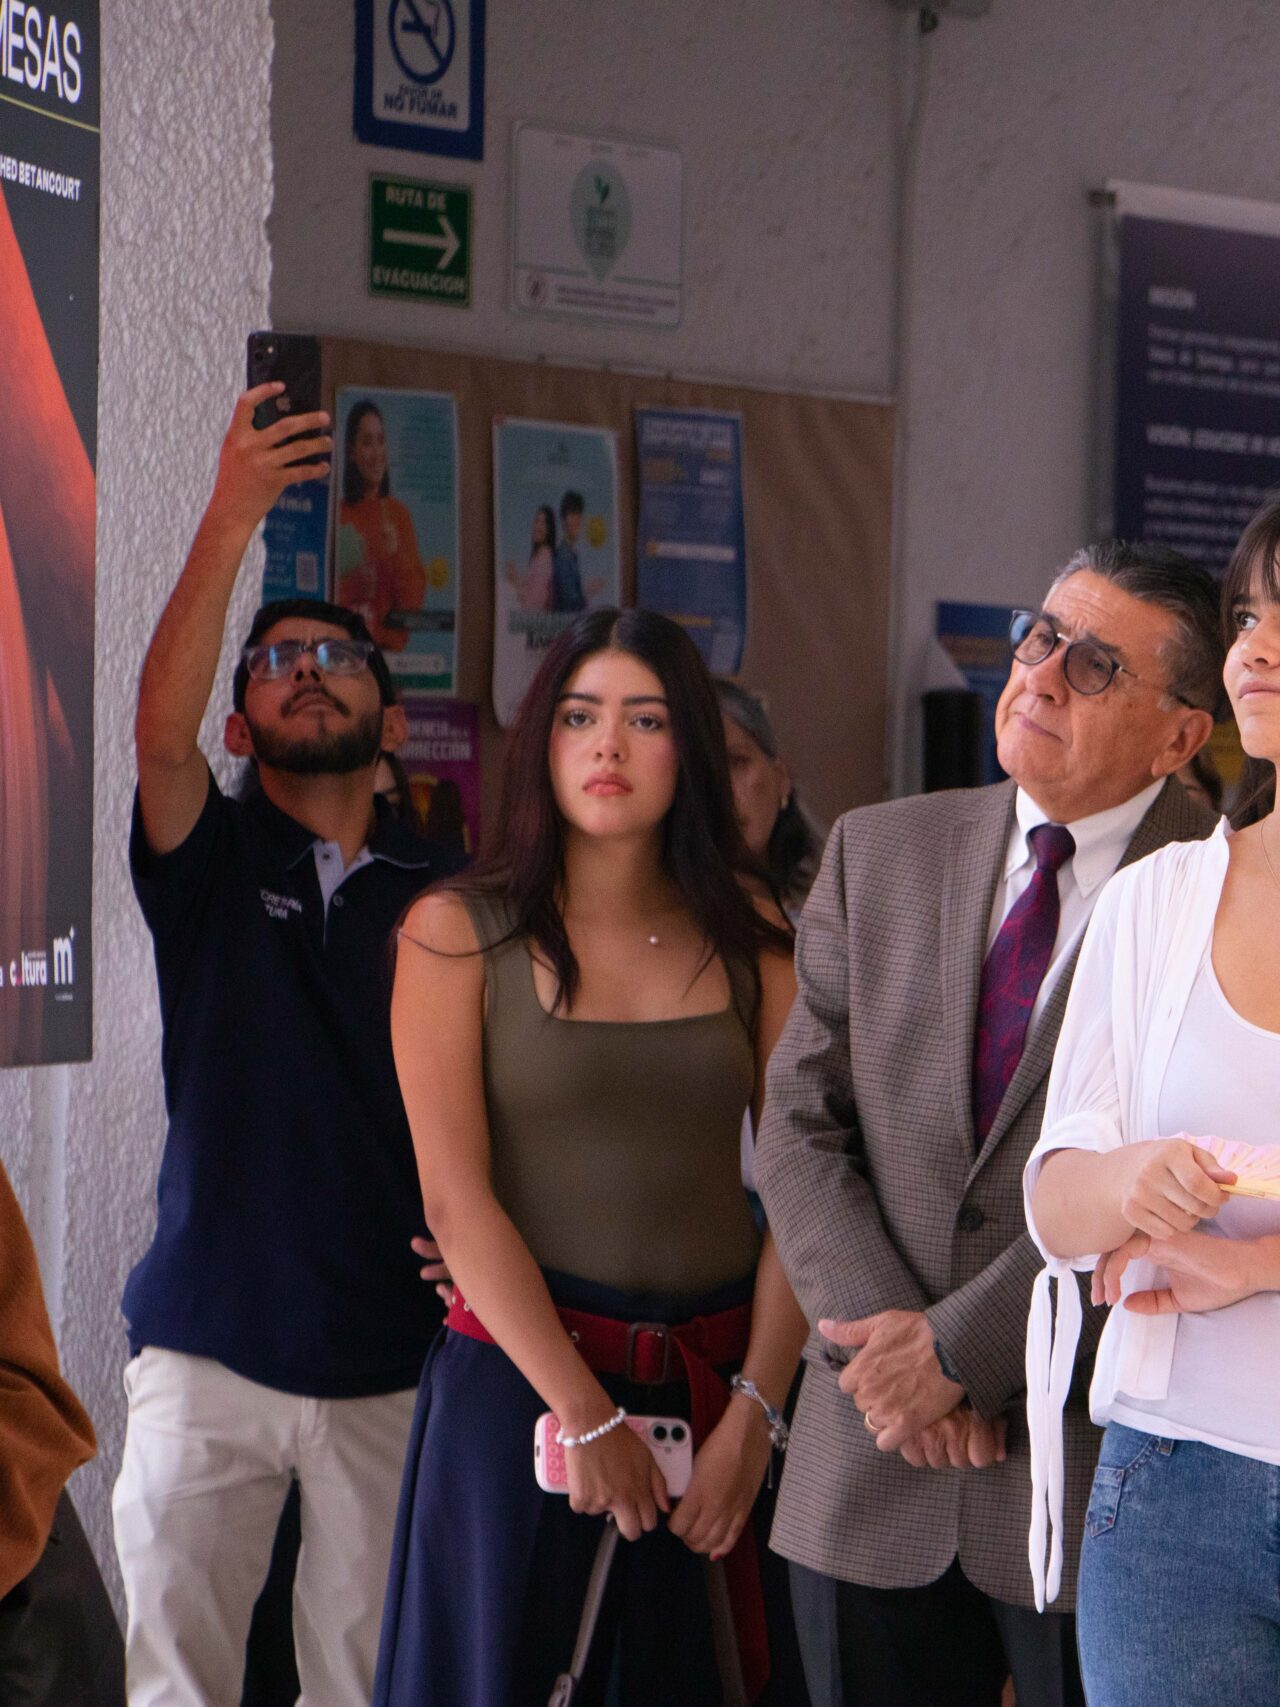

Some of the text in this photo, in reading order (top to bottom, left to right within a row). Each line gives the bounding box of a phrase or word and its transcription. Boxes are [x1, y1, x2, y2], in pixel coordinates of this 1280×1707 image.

[383, 92, 458, 119] NO FUMAR
[18, 159, 81, 201] BETANCOURT
[385, 186, 447, 211] RUTA DE
[372, 265, 465, 295] EVACUACION
